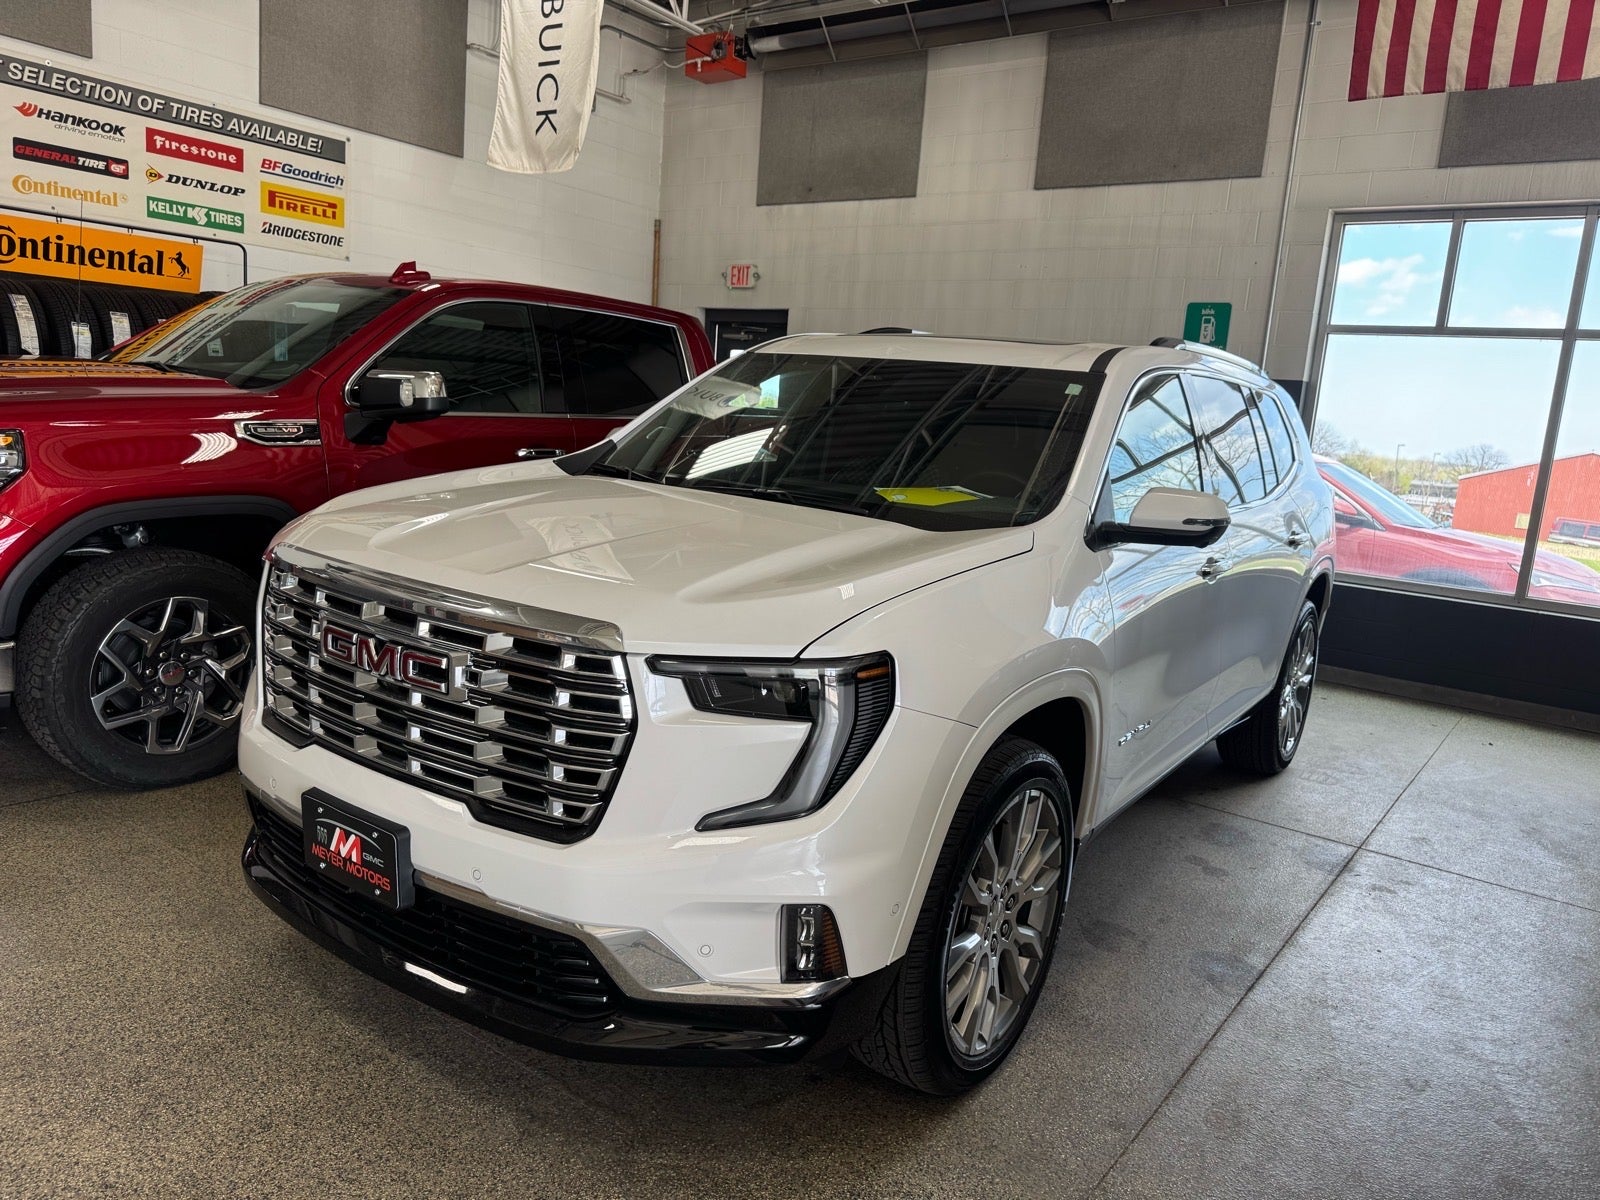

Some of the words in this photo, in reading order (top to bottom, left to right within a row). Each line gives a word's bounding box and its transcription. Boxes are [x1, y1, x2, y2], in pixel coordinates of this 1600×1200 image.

[535, 0, 564, 136] BUICK
[8, 62, 133, 107] SELECTION
[137, 95, 166, 114] OF
[170, 102, 224, 129] TIRES
[227, 118, 324, 153] AVAILABLE!
[54, 123, 87, 136] driving
[88, 132, 126, 143] emotion
[153, 135, 238, 164] Firestone
[165, 173, 246, 196] DUNLOP
[261, 158, 345, 186] BFGoodrich
[12, 174, 119, 207] Continental
[149, 200, 186, 217] KELLY
[209, 211, 243, 227] TIRES
[268, 190, 338, 220] PIRELLI
[261, 221, 345, 247] BRIDGESTONE
[730, 265, 752, 286] EXIT
[322, 624, 448, 694] GMC
[311, 842, 345, 869] MEYER
[346, 862, 391, 891] MOTORS
[362, 852, 384, 868] GMC
